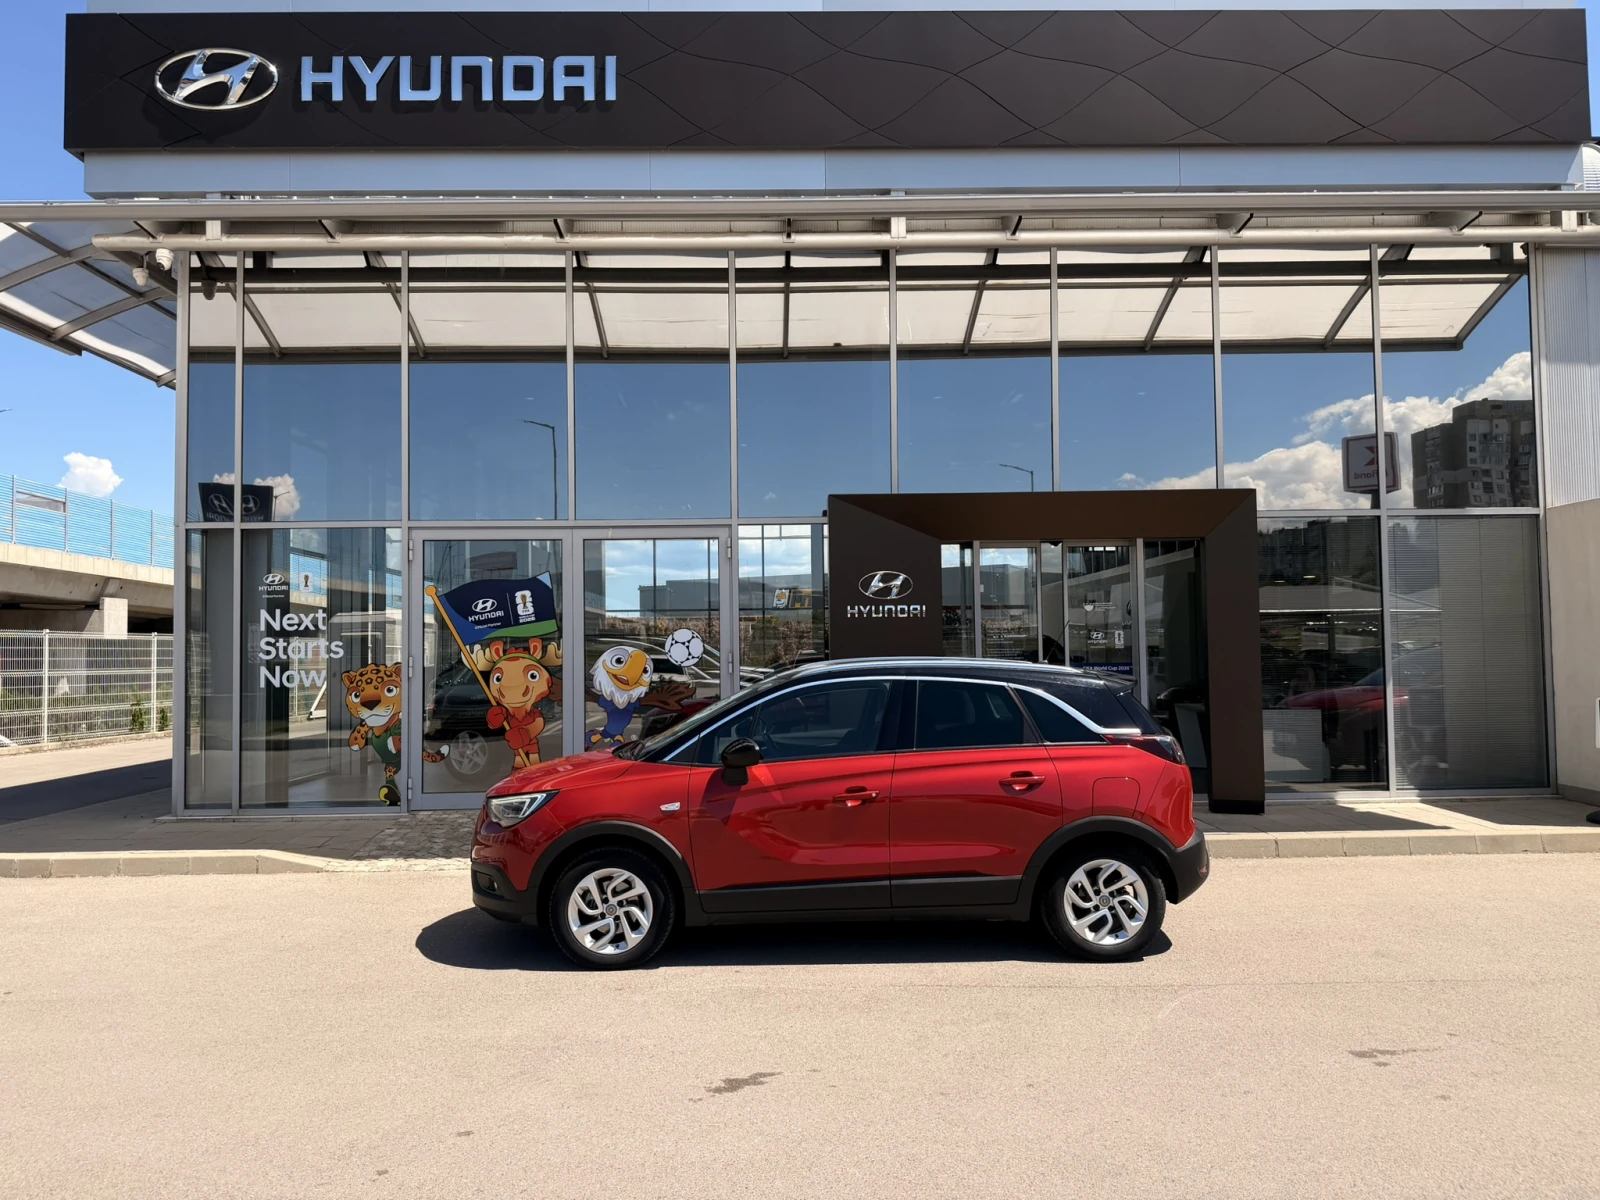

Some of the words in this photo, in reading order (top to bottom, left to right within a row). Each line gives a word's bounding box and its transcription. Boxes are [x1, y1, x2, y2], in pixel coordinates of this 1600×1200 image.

[301, 56, 617, 101] HYUNDAI
[260, 608, 326, 632] Next
[468, 610, 504, 622] HYUNDAI
[846, 604, 926, 618] HYUNDAI
[258, 637, 344, 660] Starts
[260, 665, 326, 688] Now
